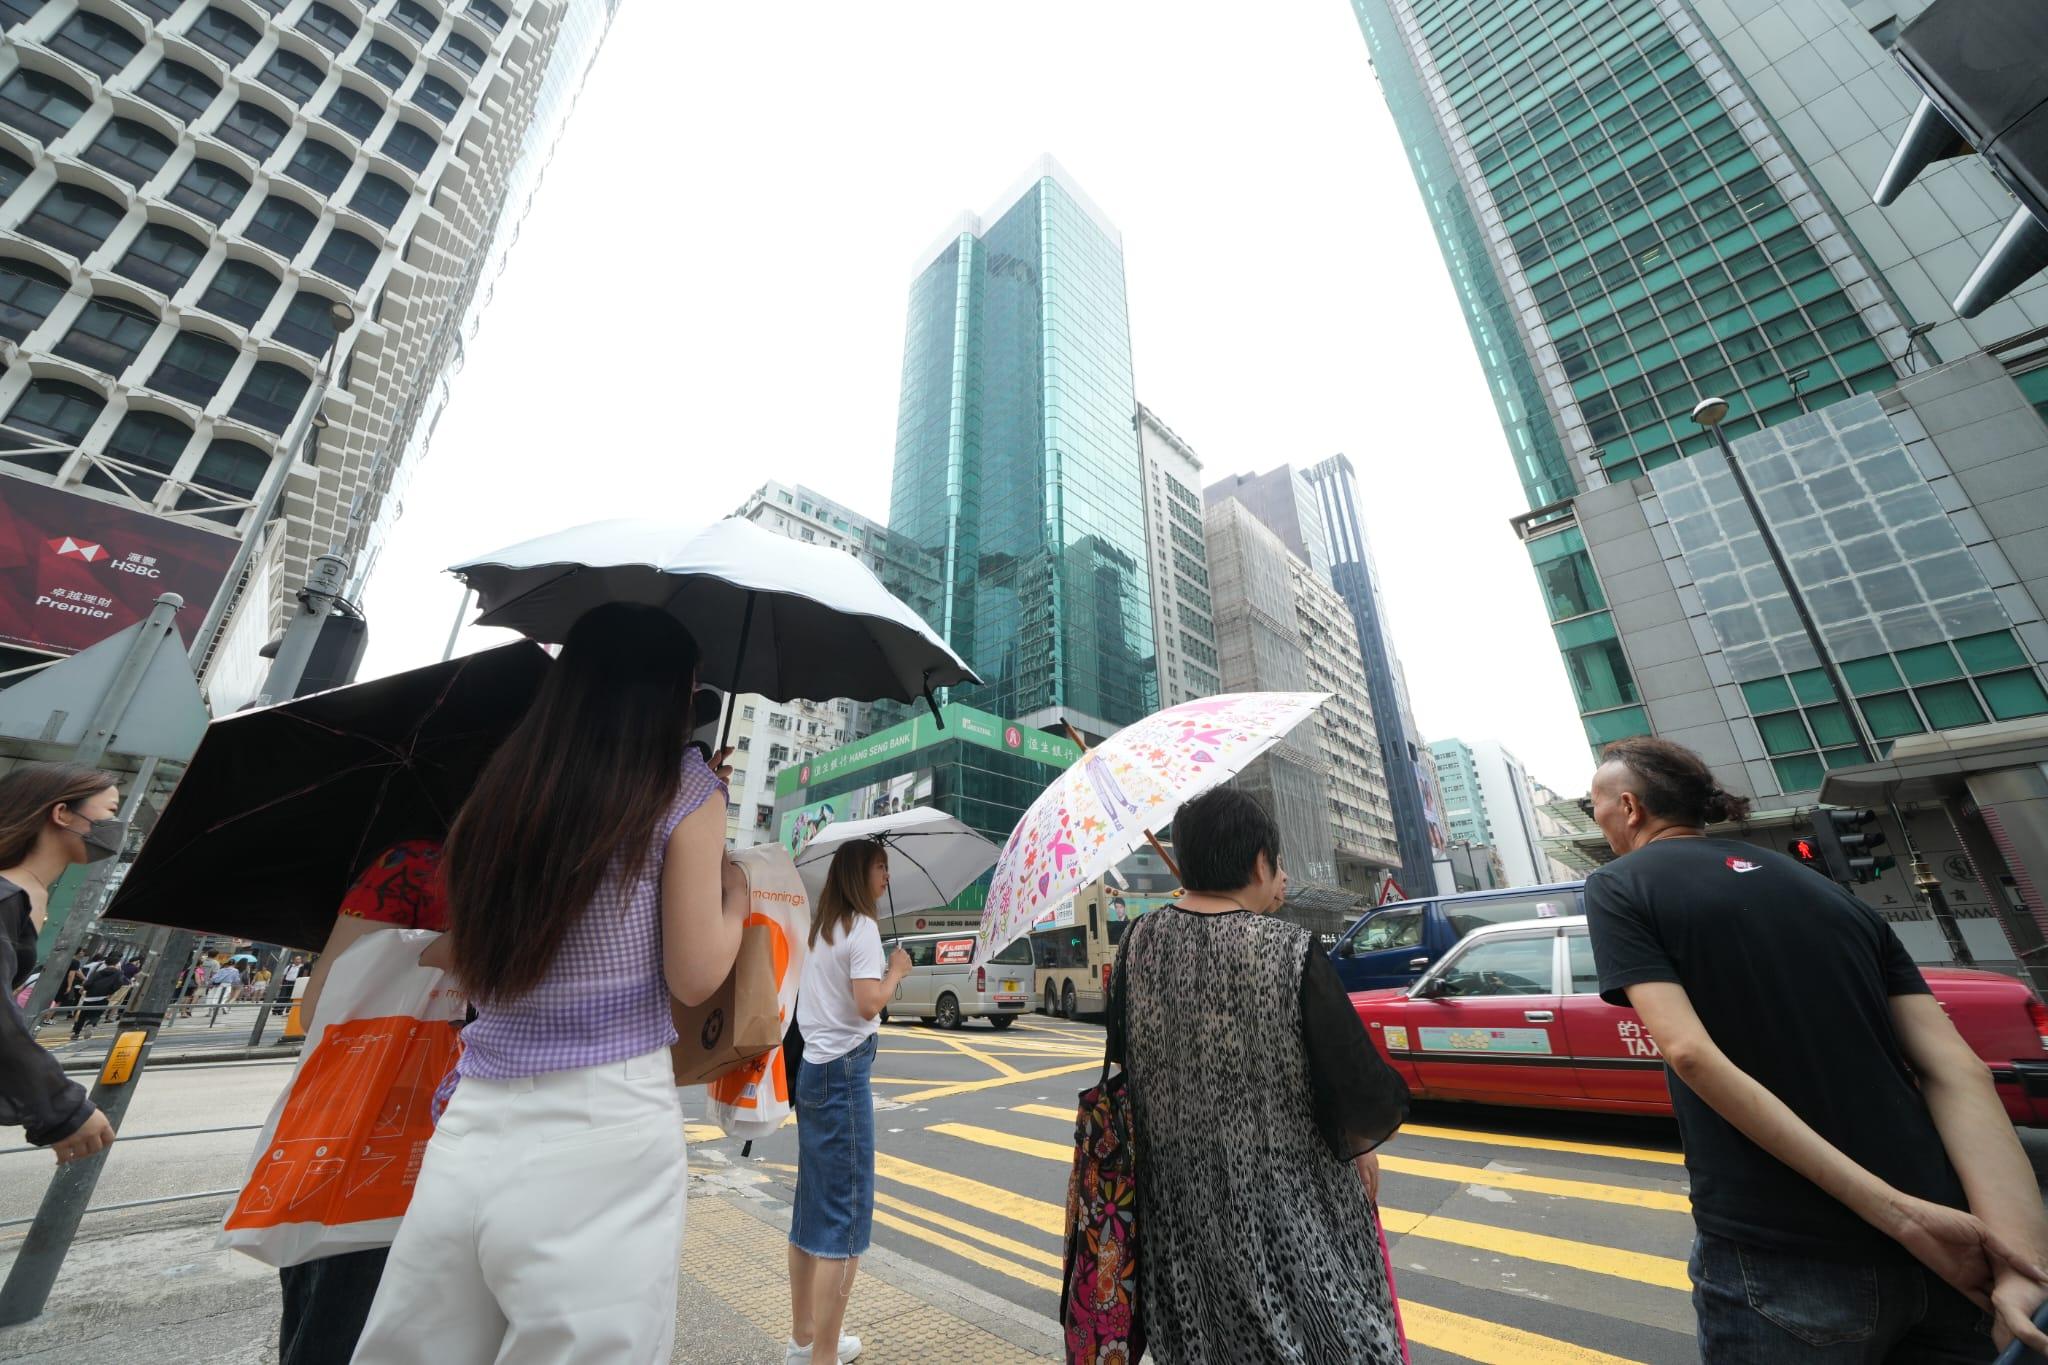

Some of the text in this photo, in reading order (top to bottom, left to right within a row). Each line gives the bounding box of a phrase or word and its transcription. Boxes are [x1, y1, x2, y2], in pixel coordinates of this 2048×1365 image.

[110, 559, 161, 579] HSBC
[35, 595, 113, 620] Premier
[51, 587, 113, 608] 卓越理財
[848, 749, 868, 764] HANG
[868, 741, 888, 757] SENG
[889, 733, 911, 749] BANK
[752, 890, 806, 906] mannings
